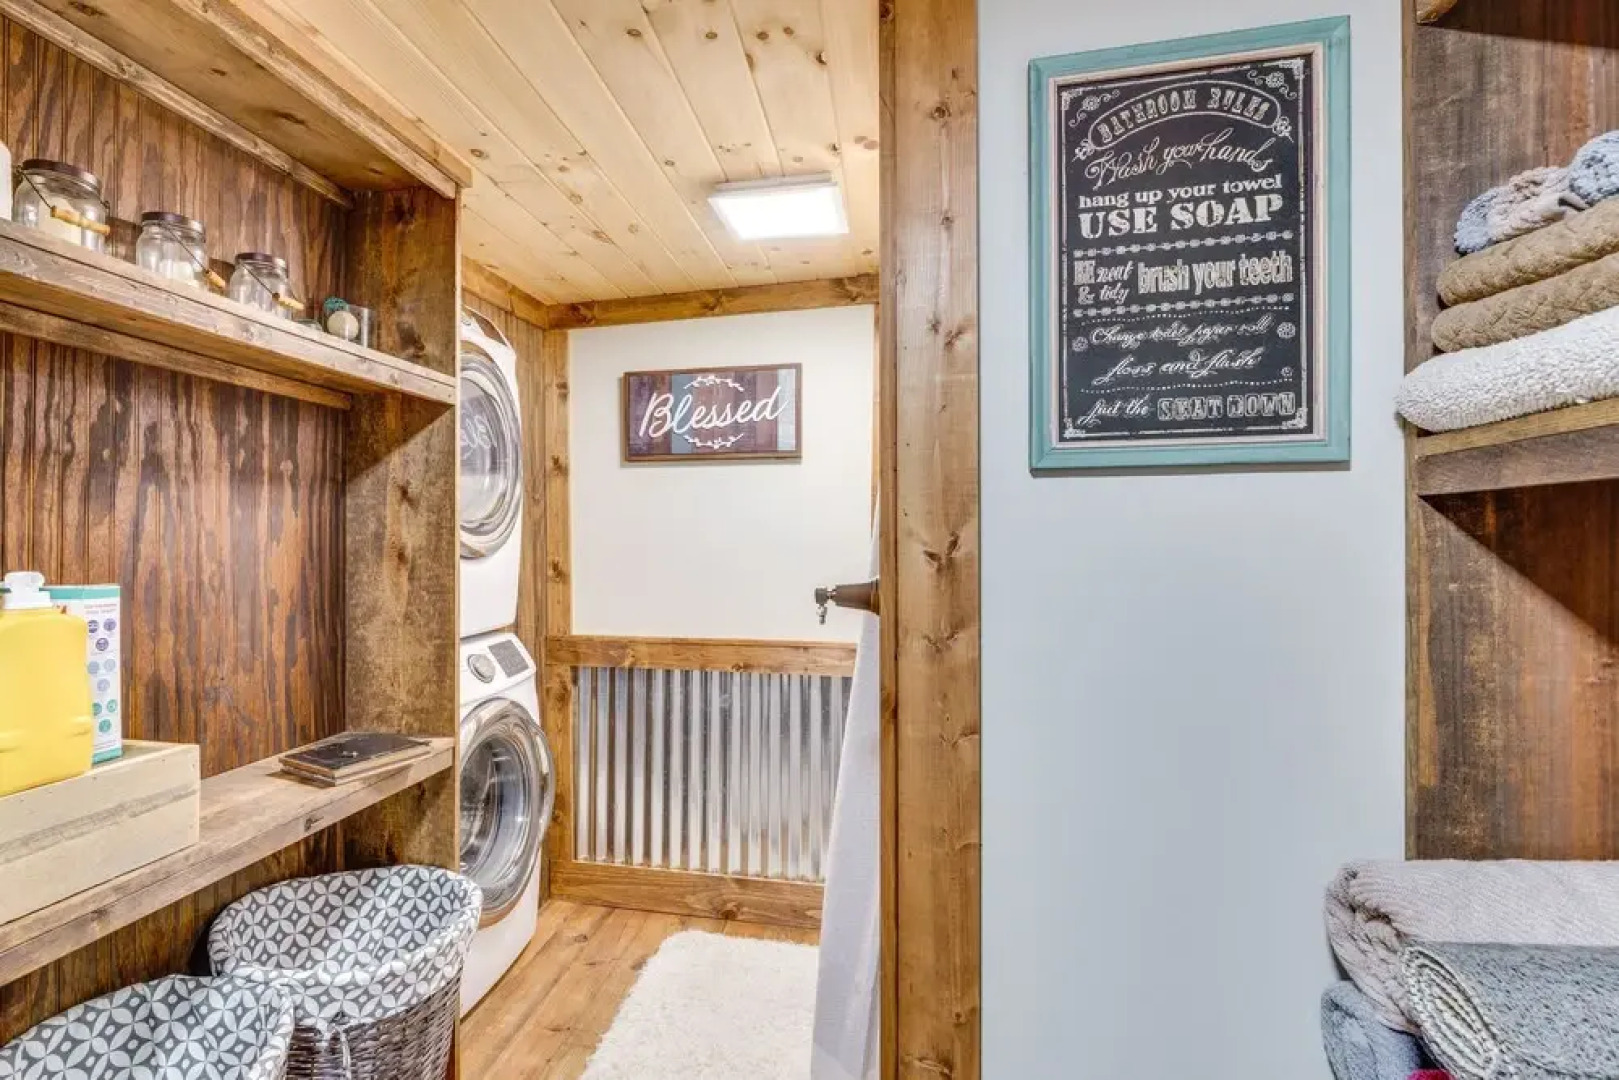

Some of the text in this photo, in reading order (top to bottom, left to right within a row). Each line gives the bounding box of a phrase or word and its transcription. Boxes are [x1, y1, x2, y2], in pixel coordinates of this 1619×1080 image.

[1097, 88, 1270, 143] BATHROOM RULES
[1084, 128, 1276, 191] Wash your hands
[1078, 173, 1283, 208] hang up your towel
[1078, 194, 1283, 239] USE SOAP
[1078, 282, 1130, 305] & tidy
[1096, 260, 1133, 283] neat
[1137, 249, 1293, 295] brush your teeth
[638, 386, 789, 438] Blessed
[1123, 393, 1150, 417] the
[1158, 396, 1223, 421] SEAT
[1227, 391, 1296, 417] DOWN
